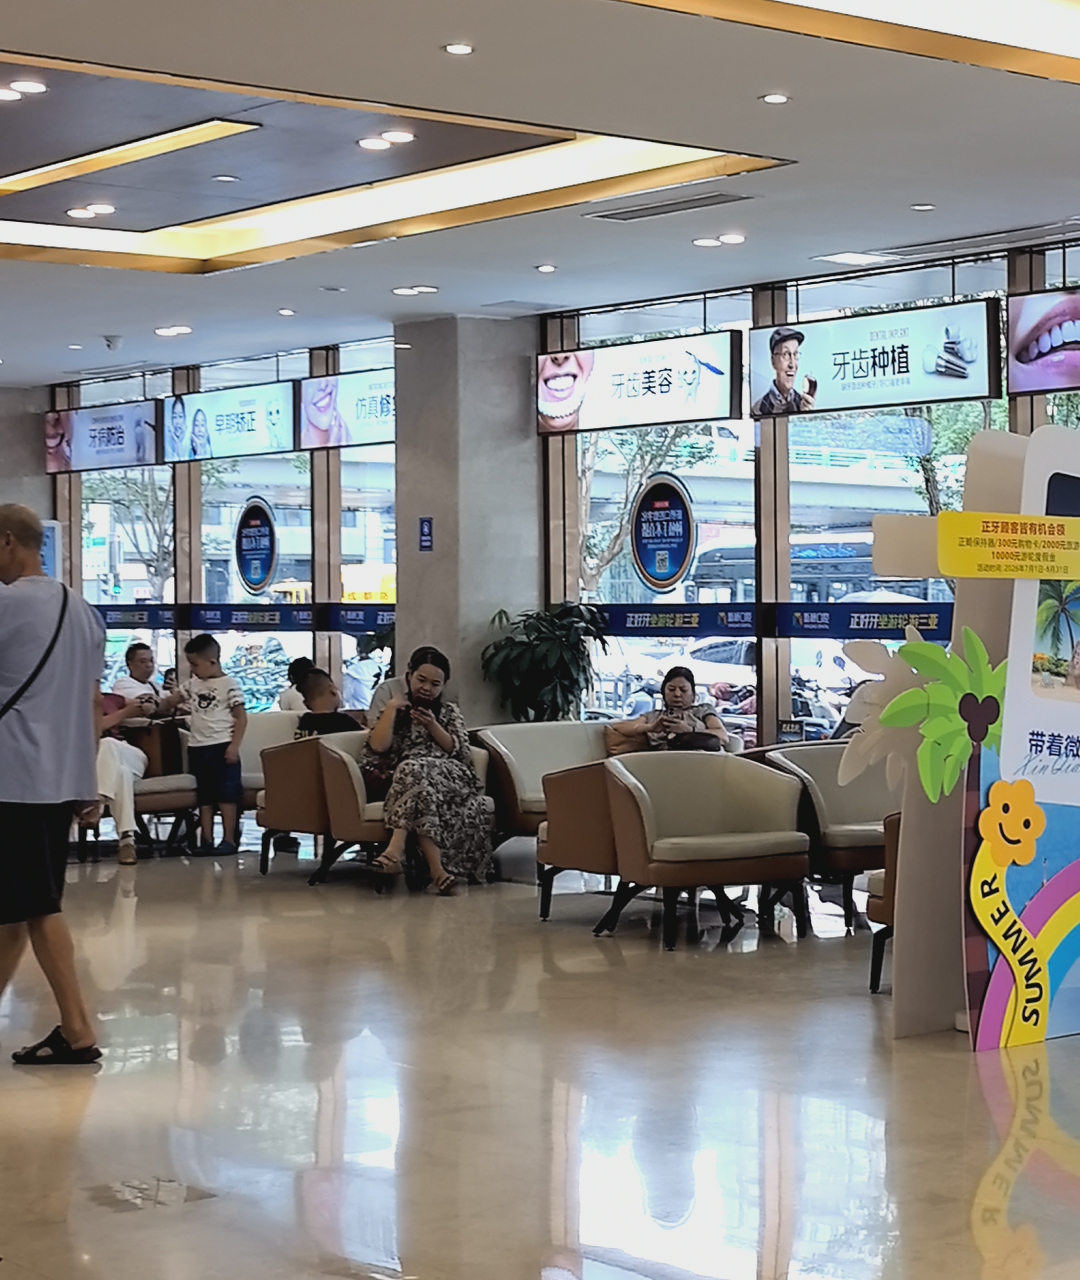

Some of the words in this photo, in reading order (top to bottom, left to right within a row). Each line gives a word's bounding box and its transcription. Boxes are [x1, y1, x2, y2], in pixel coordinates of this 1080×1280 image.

[832, 344, 911, 381] 牙齿种植
[611, 367, 673, 399] 牙齿美容
[355, 394, 395, 420] 仿真修
[215, 411, 256, 435] 早期矫正
[88, 425, 126, 448] 牙病防治
[981, 520, 1066, 535] 正牙顾客皆有机会领
[980, 872, 1043, 1027] SUMMER
